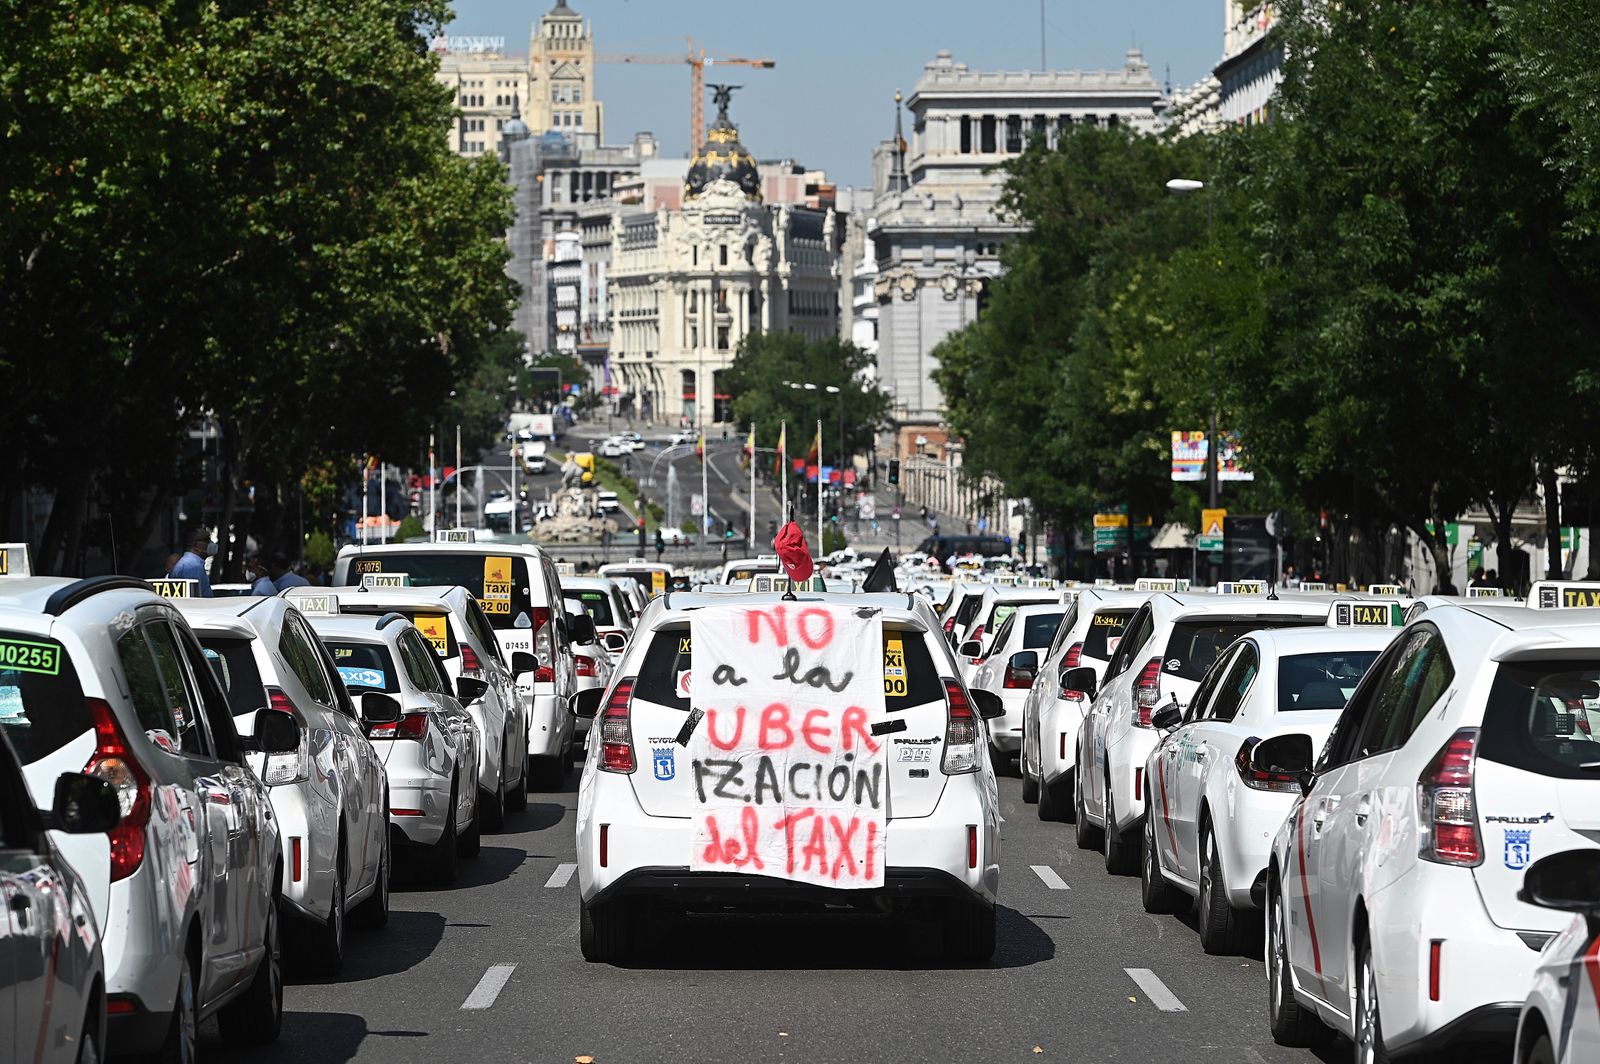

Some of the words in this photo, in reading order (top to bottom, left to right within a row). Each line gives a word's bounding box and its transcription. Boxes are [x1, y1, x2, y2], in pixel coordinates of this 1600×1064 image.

[377, 577, 401, 587] TAXI
[1234, 584, 1261, 593] TAXI
[152, 582, 186, 598] TAXI
[1379, 586, 1397, 594] TAXI
[1478, 589, 1498, 597] TAXI
[300, 598, 328, 611] TAXI
[496, 603, 509, 611] 00
[1354, 607, 1387, 623] TAXI
[746, 605, 835, 650] NO
[505, 641, 529, 649] 07459
[712, 664, 747, 686] a
[772, 648, 854, 693] la
[884, 679, 905, 693] 00
[706, 702, 882, 753] UBER
[703, 806, 765, 870] del
[773, 806, 878, 881] TAXI
